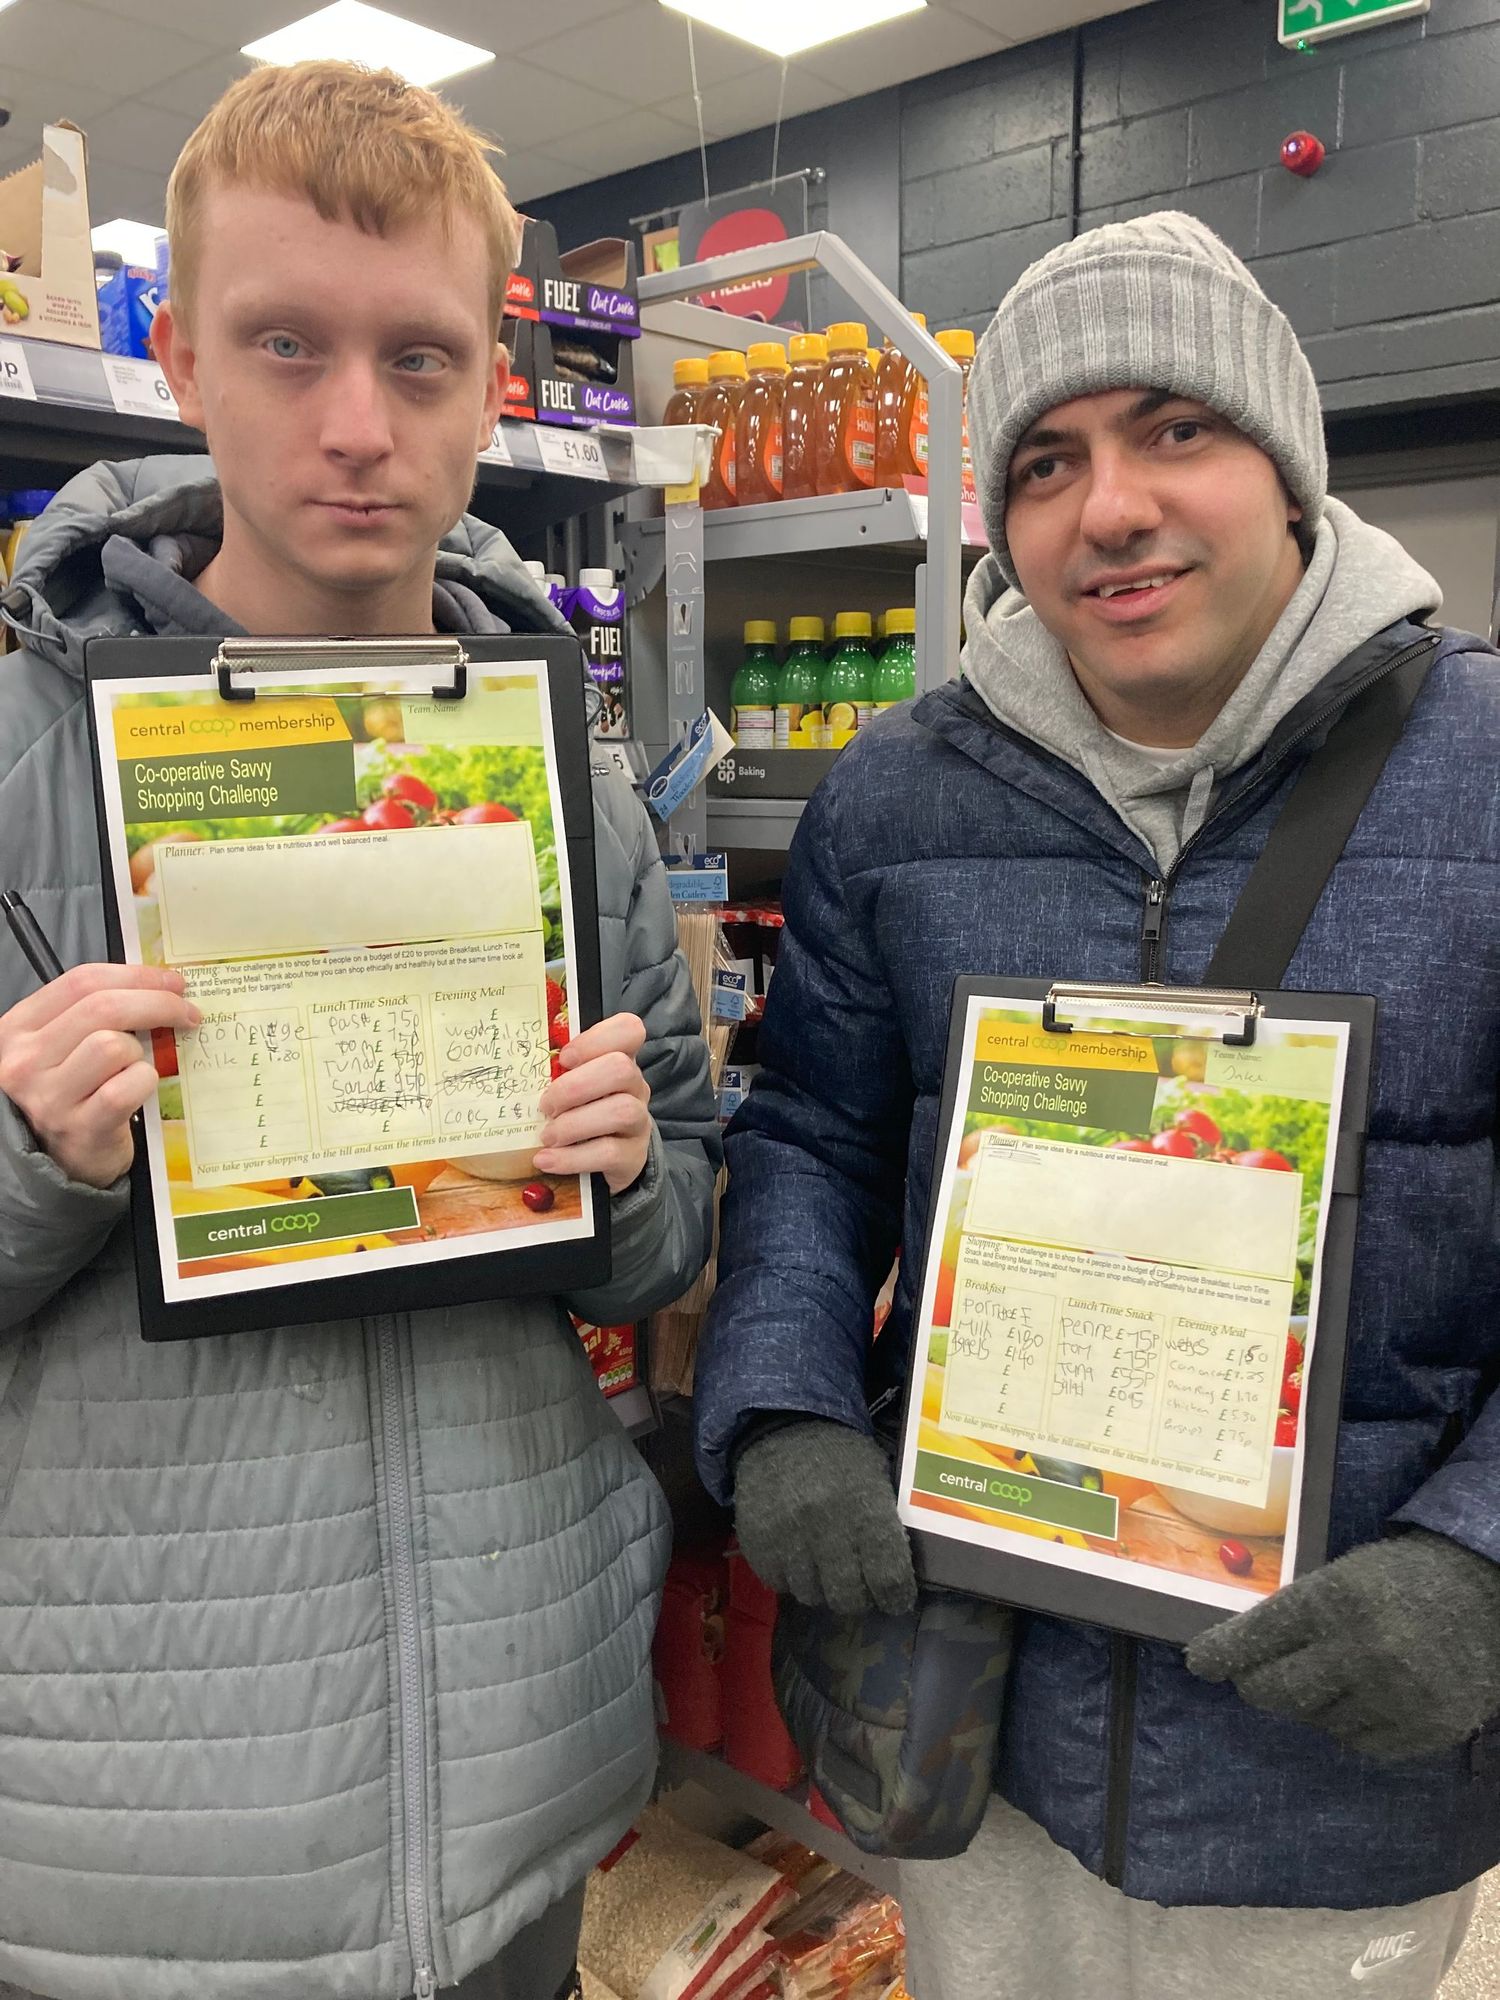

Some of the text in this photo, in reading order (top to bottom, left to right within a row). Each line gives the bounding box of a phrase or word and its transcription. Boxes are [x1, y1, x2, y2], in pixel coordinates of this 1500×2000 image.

[544, 278, 581, 312] FUEL
[541, 379, 576, 410] FUEL
[564, 441, 599, 462] £1.60
[591, 626, 622, 656] FUEL
[408, 704, 431, 714] Team
[130, 721, 185, 737] central
[240, 713, 335, 732] membership
[135, 759, 272, 786] Co-operative Savvy
[738, 766, 765, 778] Baking
[137, 784, 279, 813] Shopping Challenge
[165, 846, 205, 858] Planner:
[209, 846, 225, 855] Plan
[226, 845, 245, 853] some
[247, 843, 264, 852] ideas
[283, 840, 312, 850] nutritious
[314, 838, 327, 847] and
[328, 837, 340, 846] well
[342, 835, 371, 845] balanced
[704, 855, 720, 866] eco
[226, 965, 242, 974] Your
[243, 962, 277, 973] challenge
[278, 961, 284, 969] is
[285, 960, 292, 968] to
[293, 958, 311, 969] shop
[312, 957, 321, 966] for
[328, 955, 351, 967] people
[370, 952, 392, 963] budget
[394, 951, 400, 959] of
[402, 950, 414, 960] £20
[415, 950, 422, 958] to
[424, 947, 448, 958] provide
[483, 943, 503, 953] Lunch
[505, 942, 520, 951] Time
[185, 980, 197, 989] ack
[200, 979, 212, 987] and
[214, 976, 242, 988] Evening
[263, 972, 283, 981] Think
[284, 970, 303, 979] about
[304, 970, 319, 978] how
[320, 969, 333, 979] you
[349, 965, 365, 975] shop
[367, 961, 393, 973] ethically
[395, 960, 407, 969] and
[409, 959, 435, 970] healthily
[437, 958, 447, 966] but
[457, 957, 467, 965] the
[469, 956, 485, 965] same
[502, 953, 515, 961] look
[722, 974, 738, 985] eco
[200, 986, 230, 997] labelling
[233, 986, 246, 994] and
[260, 981, 293, 993] bargains!
[435, 986, 506, 1002] Evening Meal
[313, 995, 408, 1014] Lunch Time Snack
[199, 1012, 237, 1026] eakfast
[987, 1035, 1029, 1047] central
[1069, 1042, 1147, 1061] membership
[983, 1065, 1088, 1097] Co-operative Savvy
[980, 1086, 1087, 1118] Shopping Challenge
[197, 1124, 537, 1174] Now take your shopping to the till and scan the items to see how close you are
[207, 1211, 320, 1242] central coop
[965, 1278, 1006, 1295] Breakfast
[1068, 1297, 1154, 1321] Lunch Time Snack
[1178, 1316, 1247, 1338] Evening Meal
[939, 1470, 1032, 1507] central coop
[1363, 1930, 1417, 1962] NIKE
